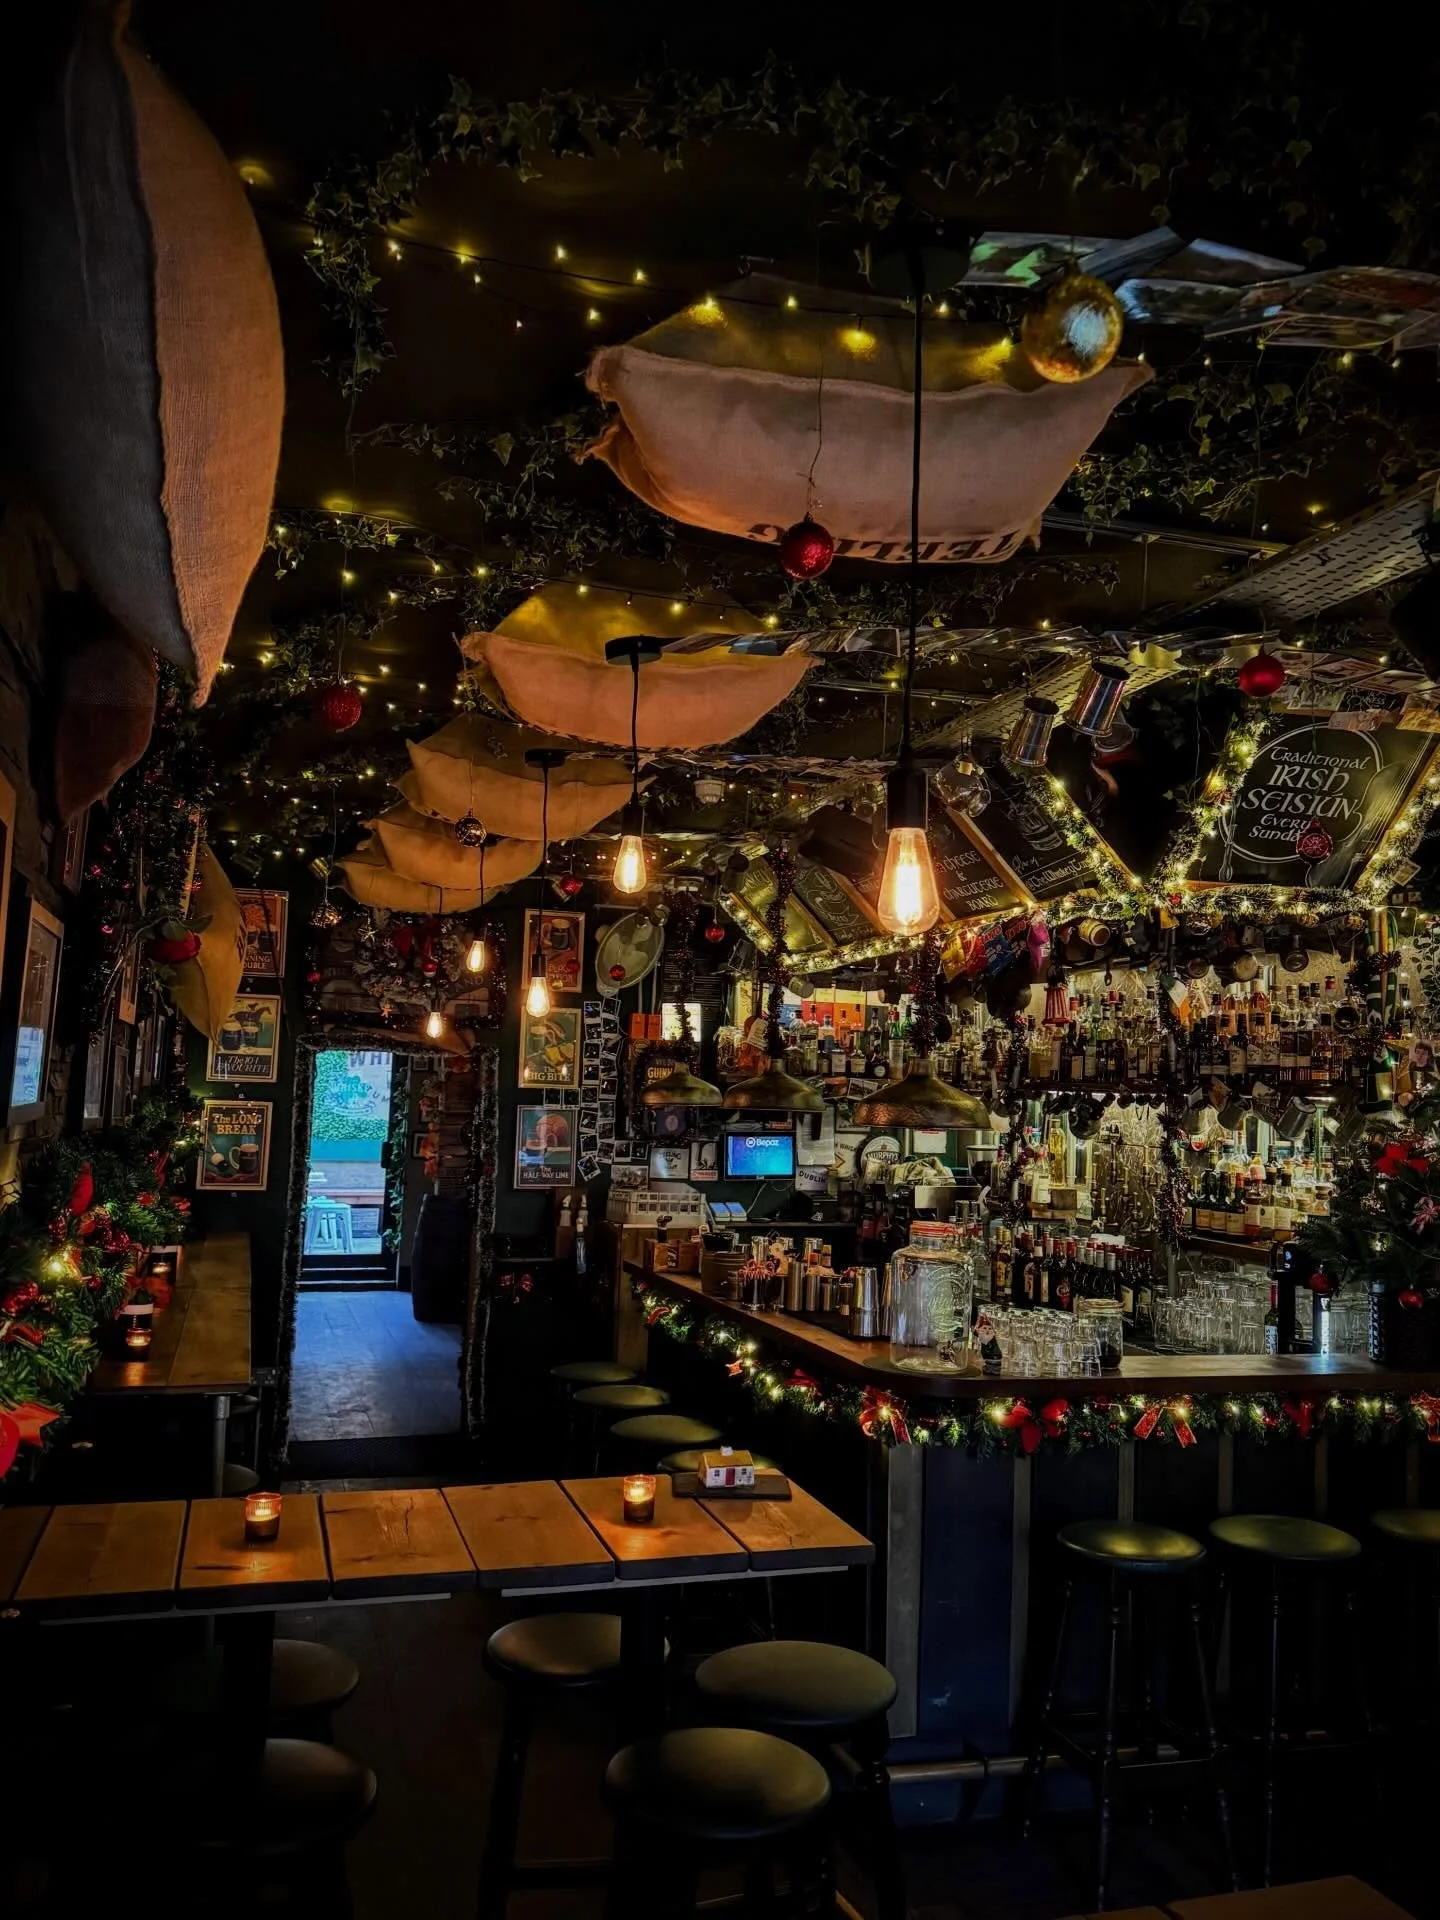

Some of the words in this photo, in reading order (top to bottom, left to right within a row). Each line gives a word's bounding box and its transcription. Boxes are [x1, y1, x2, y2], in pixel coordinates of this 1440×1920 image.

[747, 523, 1020, 560] TEELIG
[1249, 825, 1302, 843] Sunda
[216, 1124, 257, 1135] BREAK
[799, 1169, 826, 1183] DUBLIN
